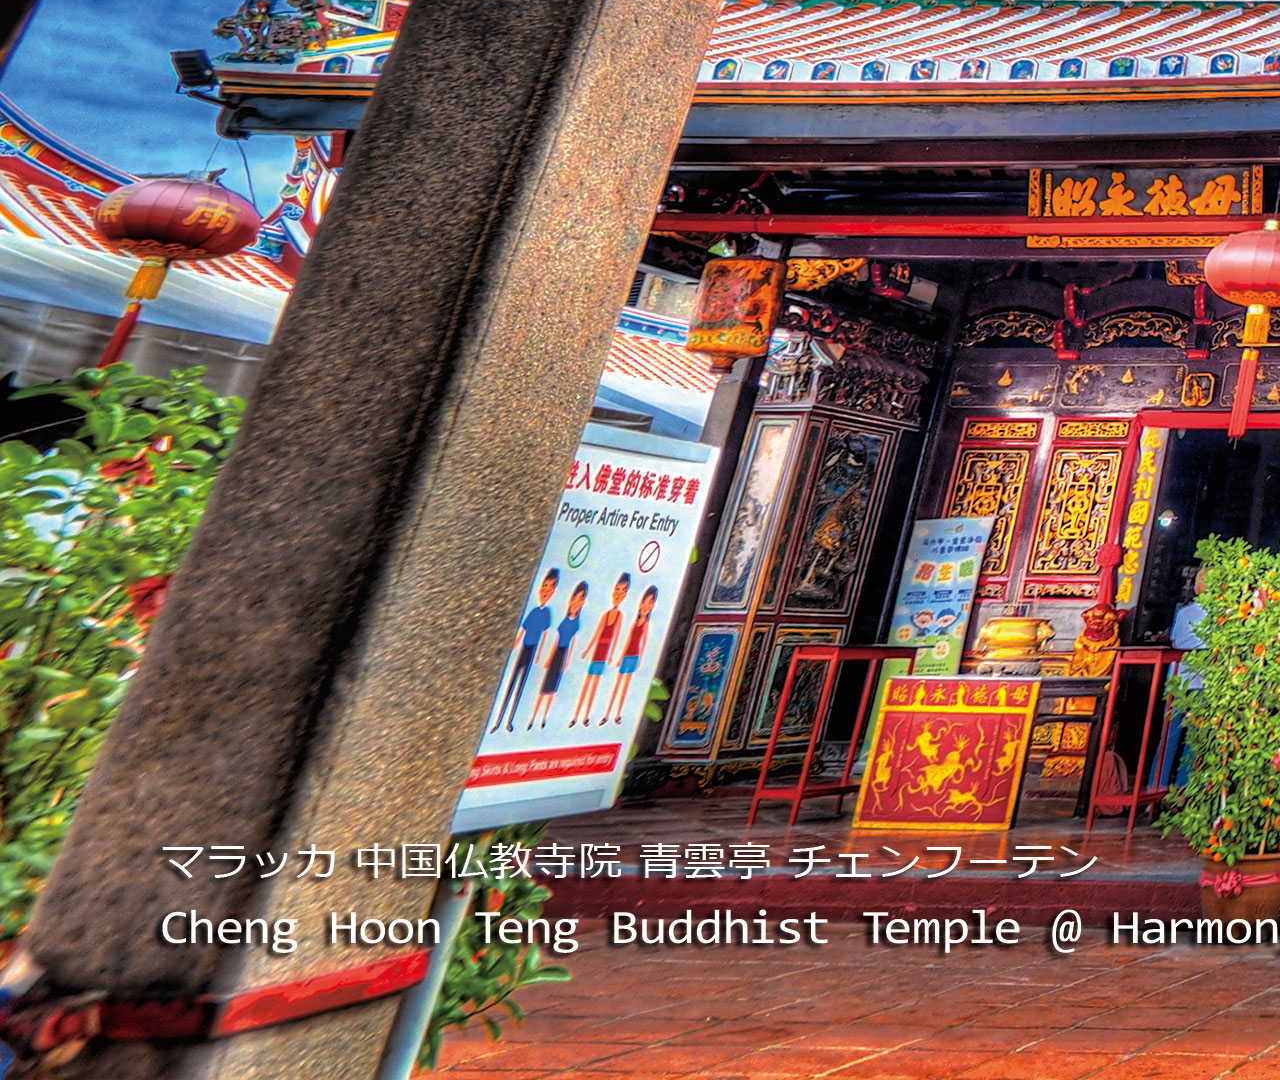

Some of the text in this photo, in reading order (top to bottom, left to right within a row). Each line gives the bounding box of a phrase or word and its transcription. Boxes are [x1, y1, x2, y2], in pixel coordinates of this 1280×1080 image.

[557, 502, 680, 537] Proper Artire For Entry
